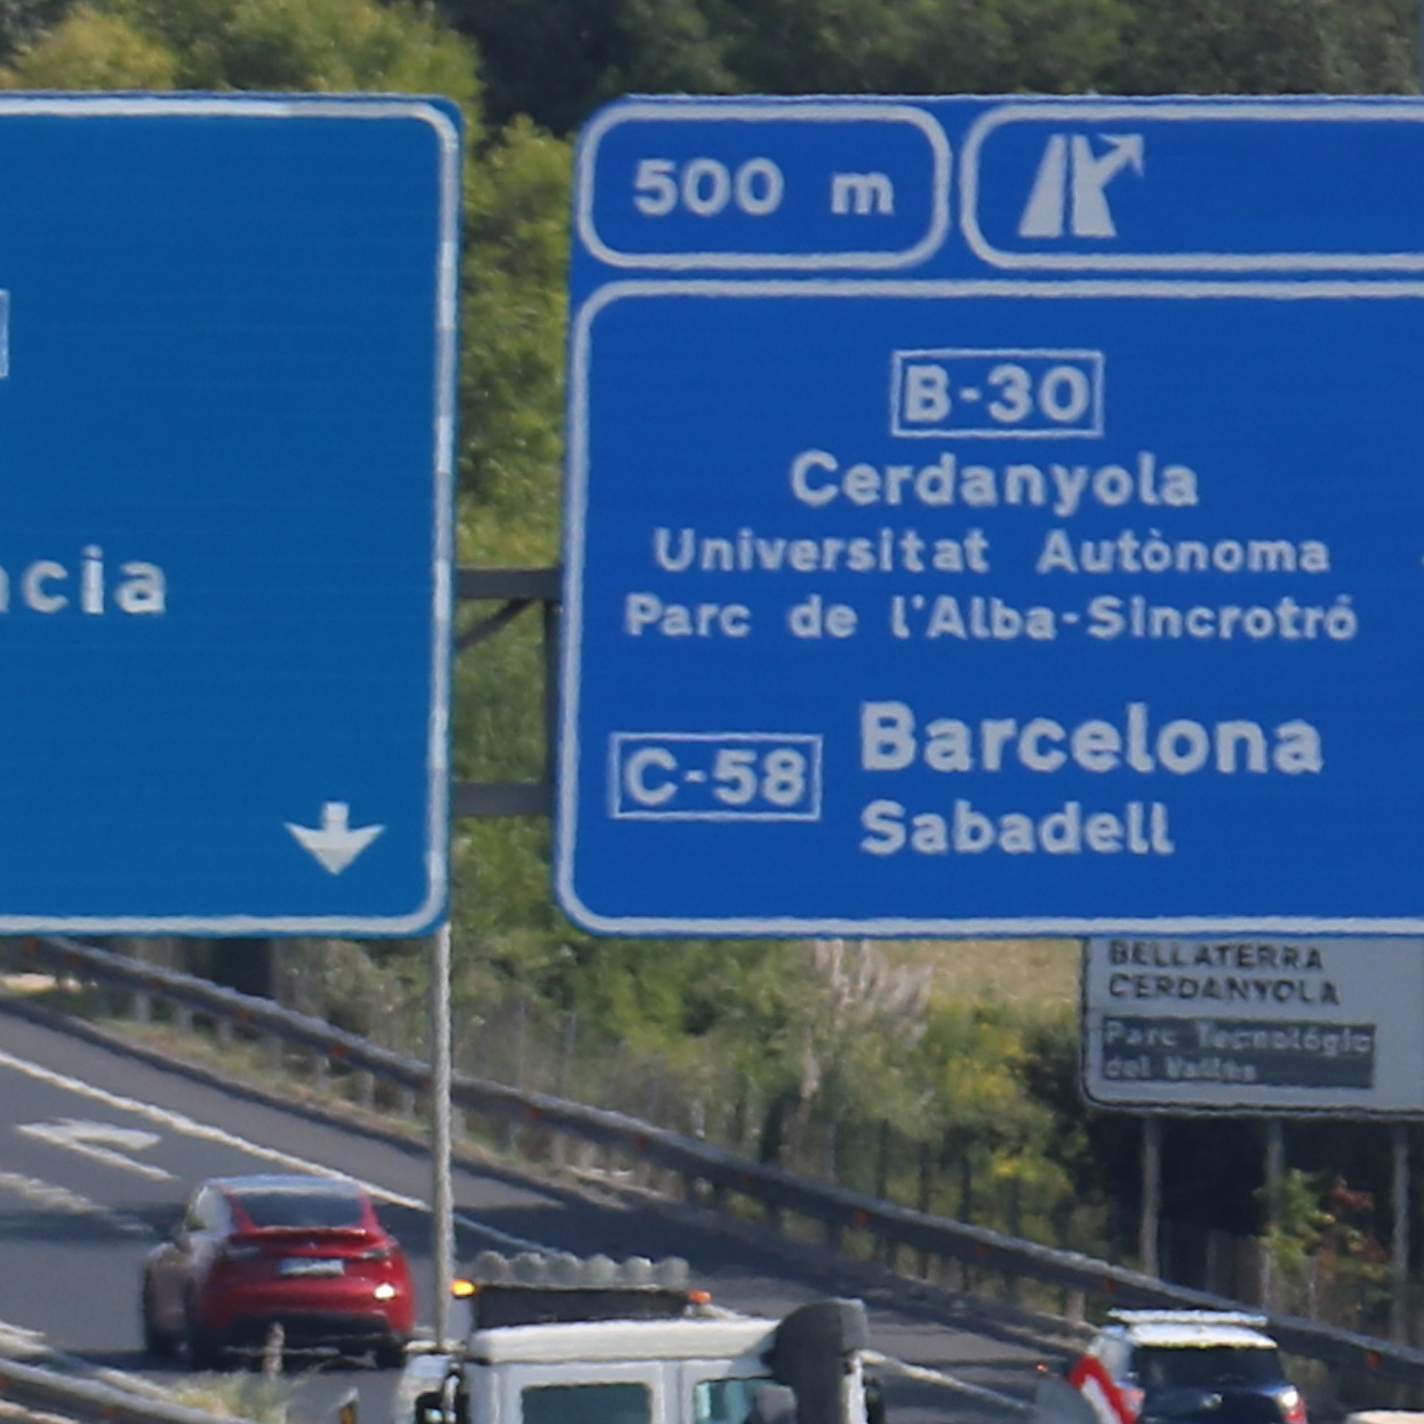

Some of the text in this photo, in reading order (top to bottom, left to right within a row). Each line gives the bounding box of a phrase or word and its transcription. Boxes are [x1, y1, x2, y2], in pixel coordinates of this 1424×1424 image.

[633, 159, 895, 215] 500 m
[906, 364, 1088, 422] B-30
[791, 451, 1197, 517] Cerdanyola
[654, 529, 1329, 574] Universitat Autònoma
[626, 594, 1358, 641] Parc de l'Alba-Sincrotró
[861, 702, 1323, 776] Barcelona
[624, 748, 805, 806] C-58
[861, 801, 1172, 855] Sabadell
[1109, 940, 1324, 969] BELLATERRA
[1109, 973, 1339, 1005] CERDANYOLA
[1105, 1021, 1177, 1046] Parc
